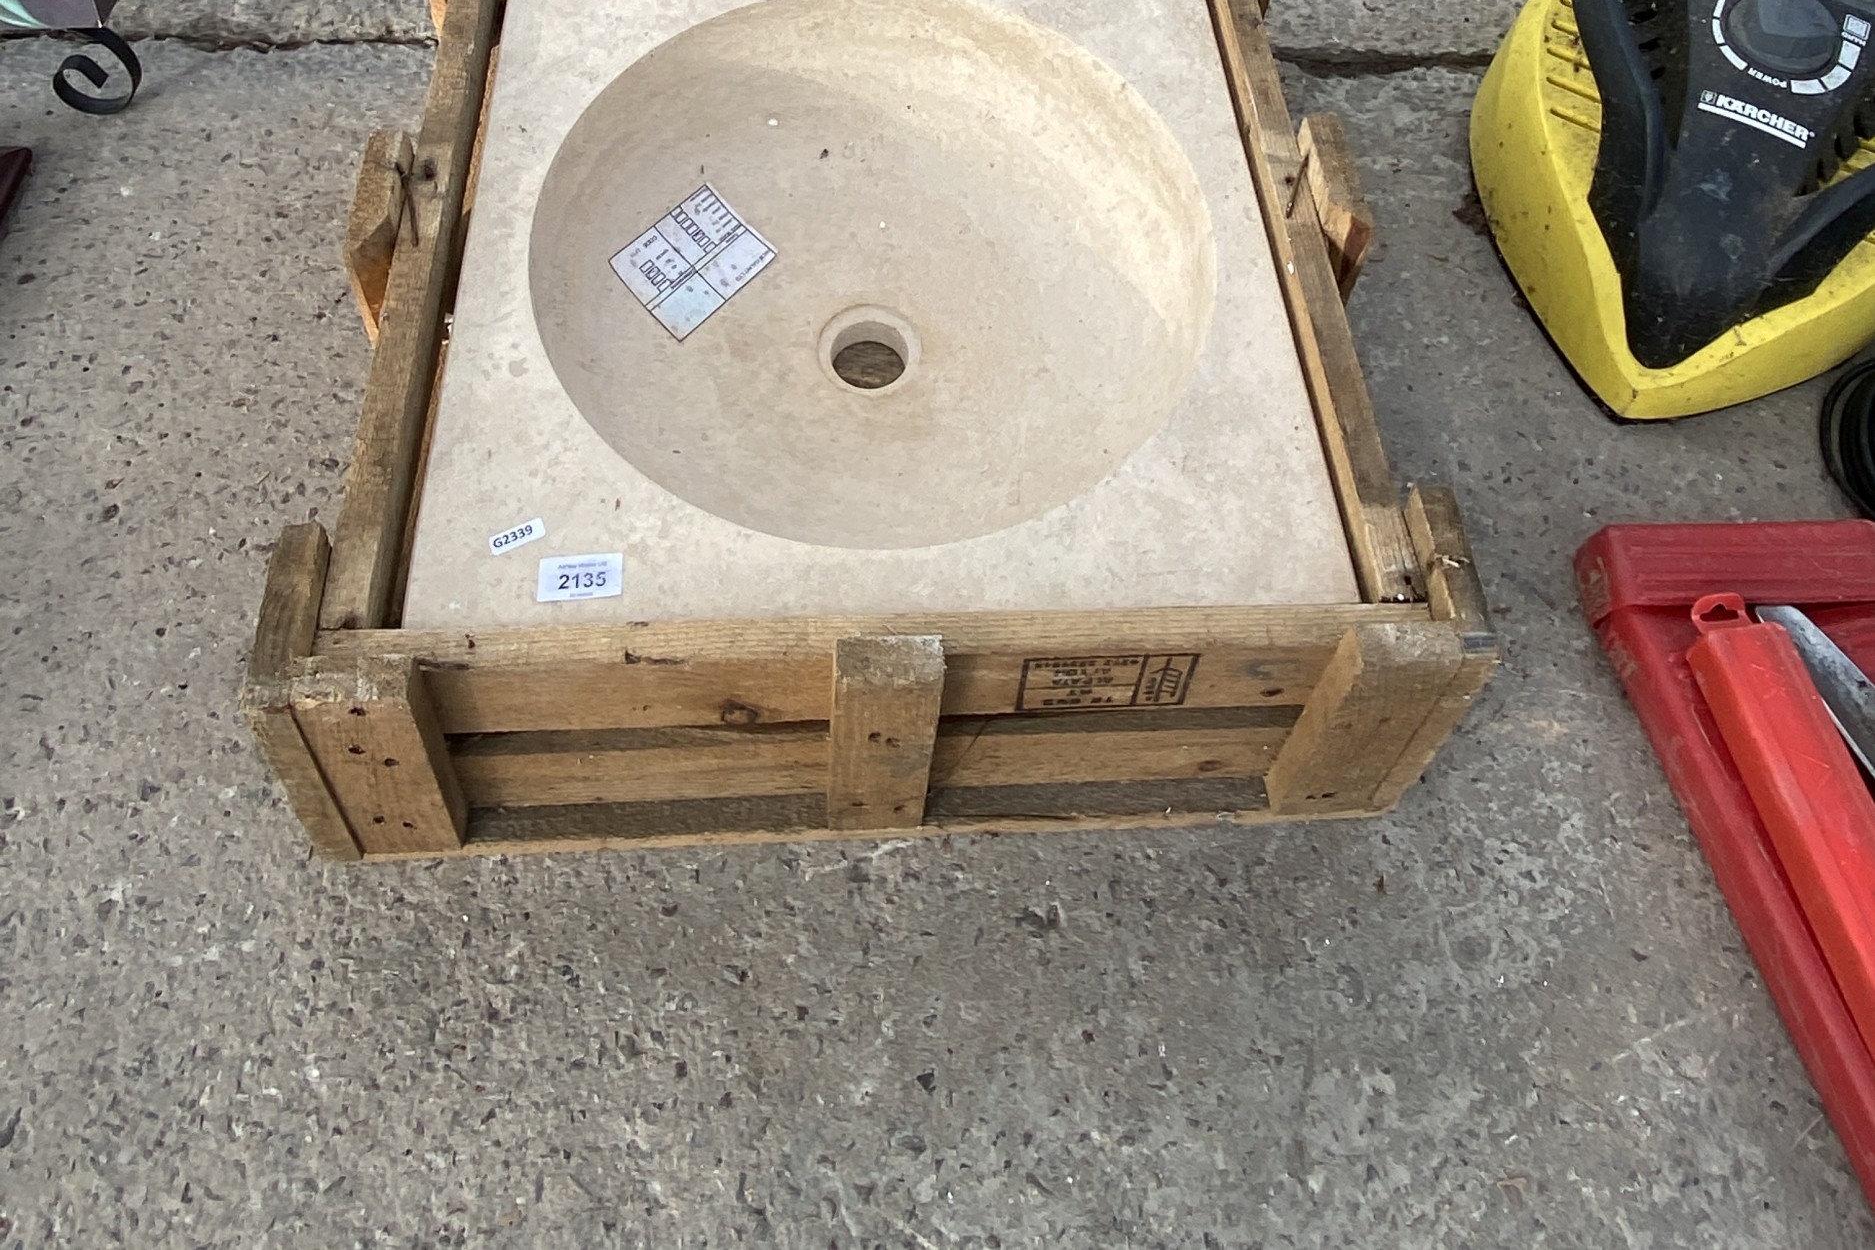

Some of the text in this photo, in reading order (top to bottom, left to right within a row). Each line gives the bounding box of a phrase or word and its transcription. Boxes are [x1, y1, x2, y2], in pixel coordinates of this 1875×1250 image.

[1747, 67, 1788, 89] POWER
[493, 524, 533, 548] G2339
[558, 571, 607, 590] 2135
